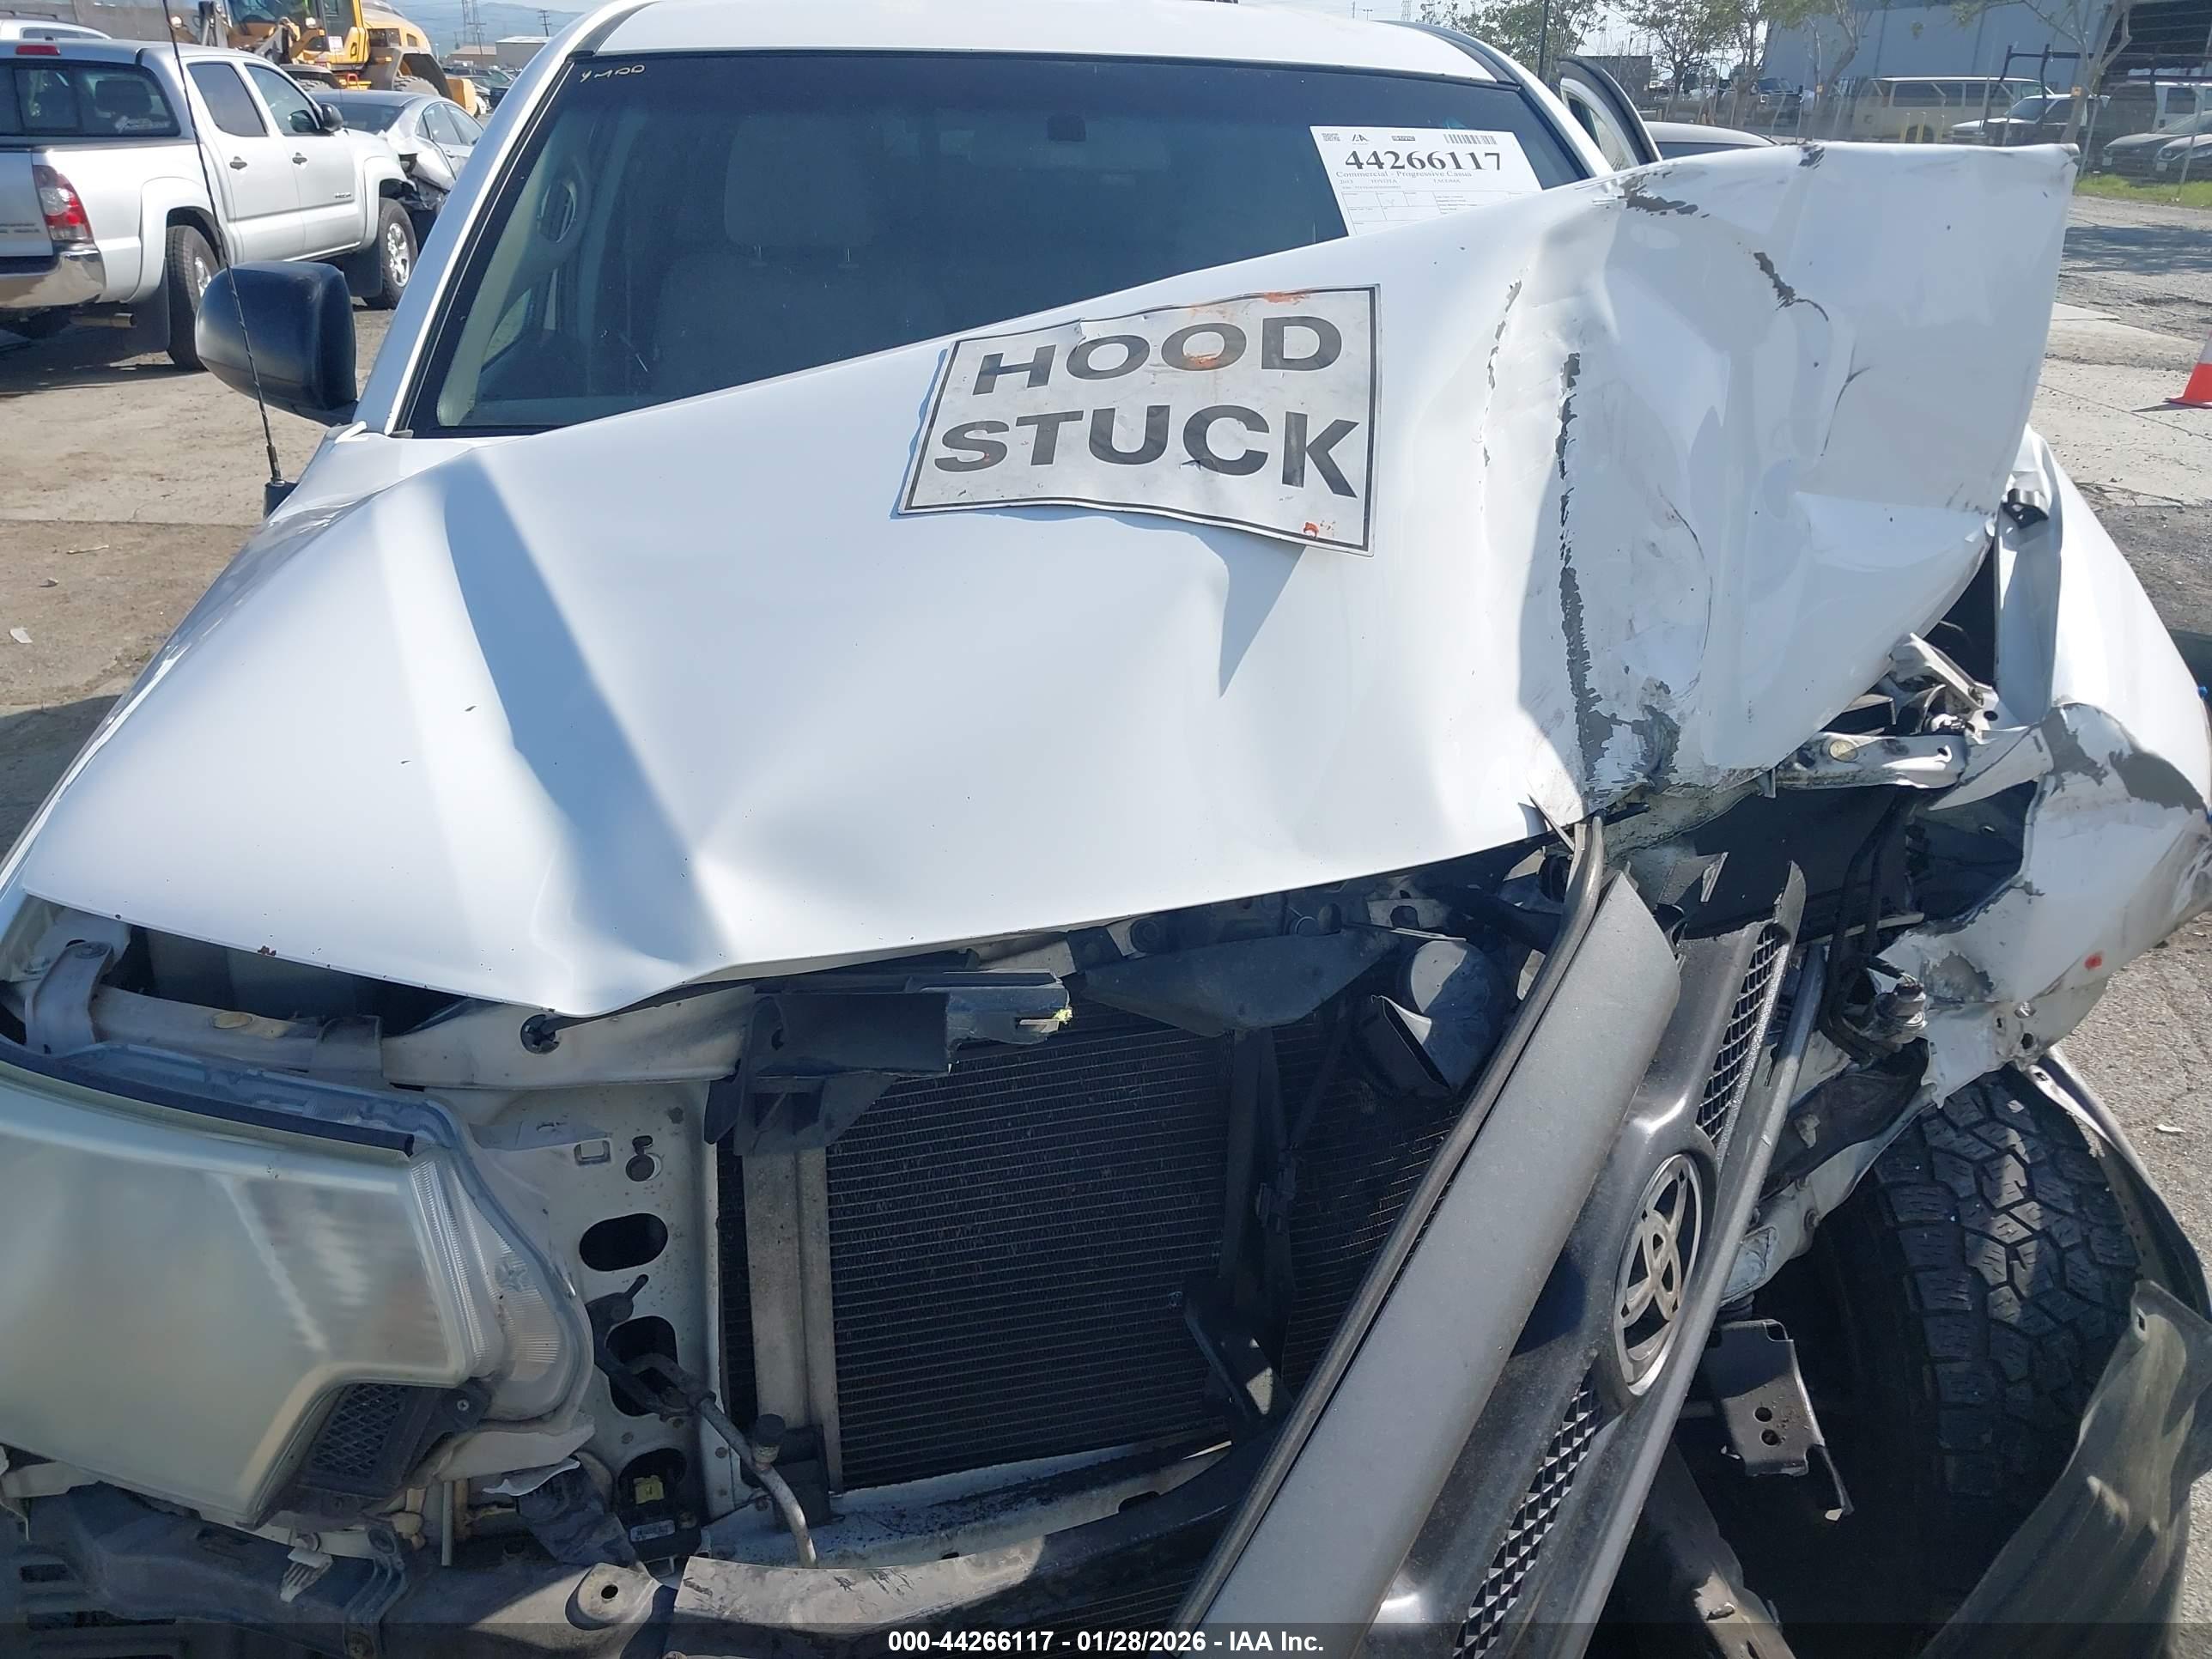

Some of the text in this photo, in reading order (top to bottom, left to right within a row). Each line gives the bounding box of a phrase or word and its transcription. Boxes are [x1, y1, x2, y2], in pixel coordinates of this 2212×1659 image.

[1345, 150, 1501, 171] 44266117
[972, 315, 1343, 397] HOOD
[933, 404, 1360, 499] STUCK
